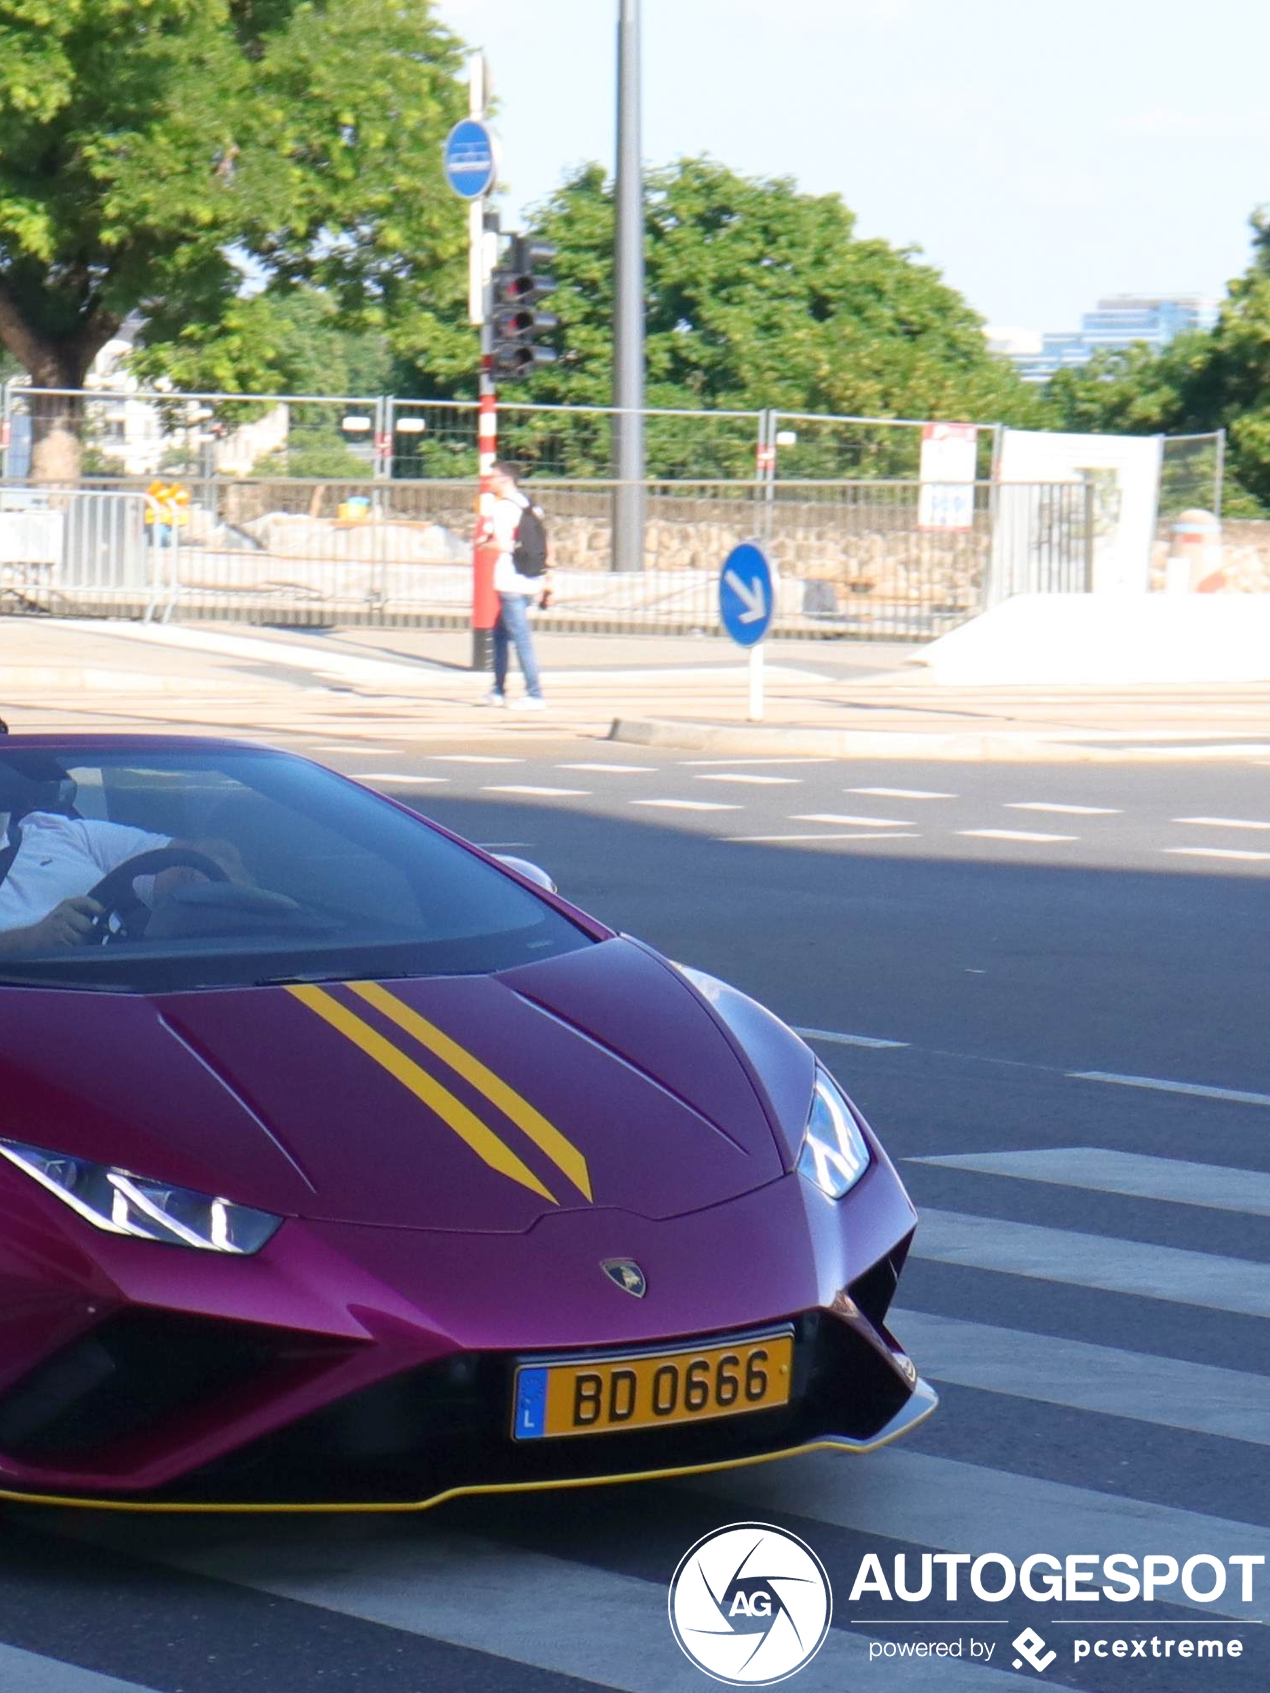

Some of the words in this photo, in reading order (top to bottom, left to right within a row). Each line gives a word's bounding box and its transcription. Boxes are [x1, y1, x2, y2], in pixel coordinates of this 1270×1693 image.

[573, 1370, 637, 1427] BD
[652, 1348, 769, 1416] 0666
[524, 1410, 535, 1428] L
